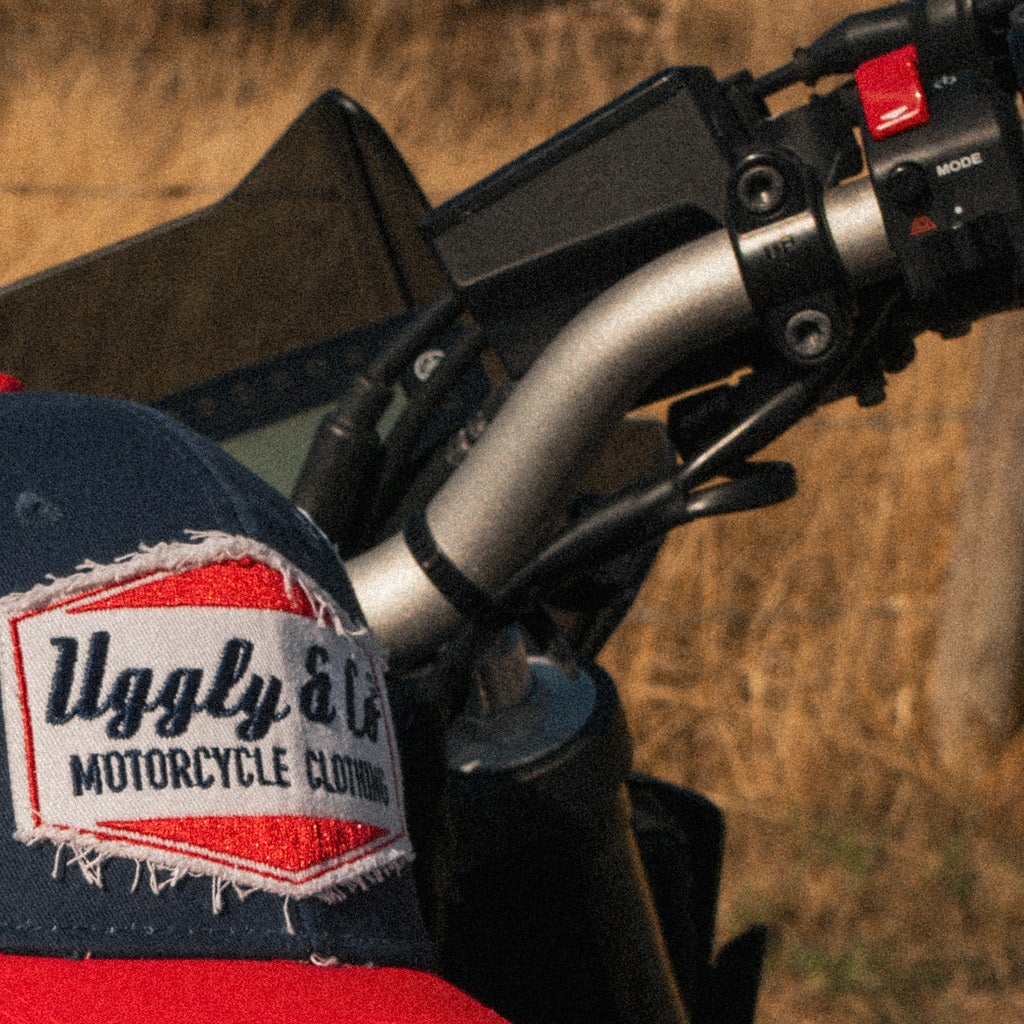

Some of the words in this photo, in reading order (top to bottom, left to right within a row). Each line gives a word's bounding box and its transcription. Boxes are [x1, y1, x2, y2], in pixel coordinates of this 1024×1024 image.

[936, 153, 983, 177] MODE
[45, 631, 290, 741] Uggly
[299, 644, 336, 725] &
[70, 746, 291, 796] MOTORCYCLE
